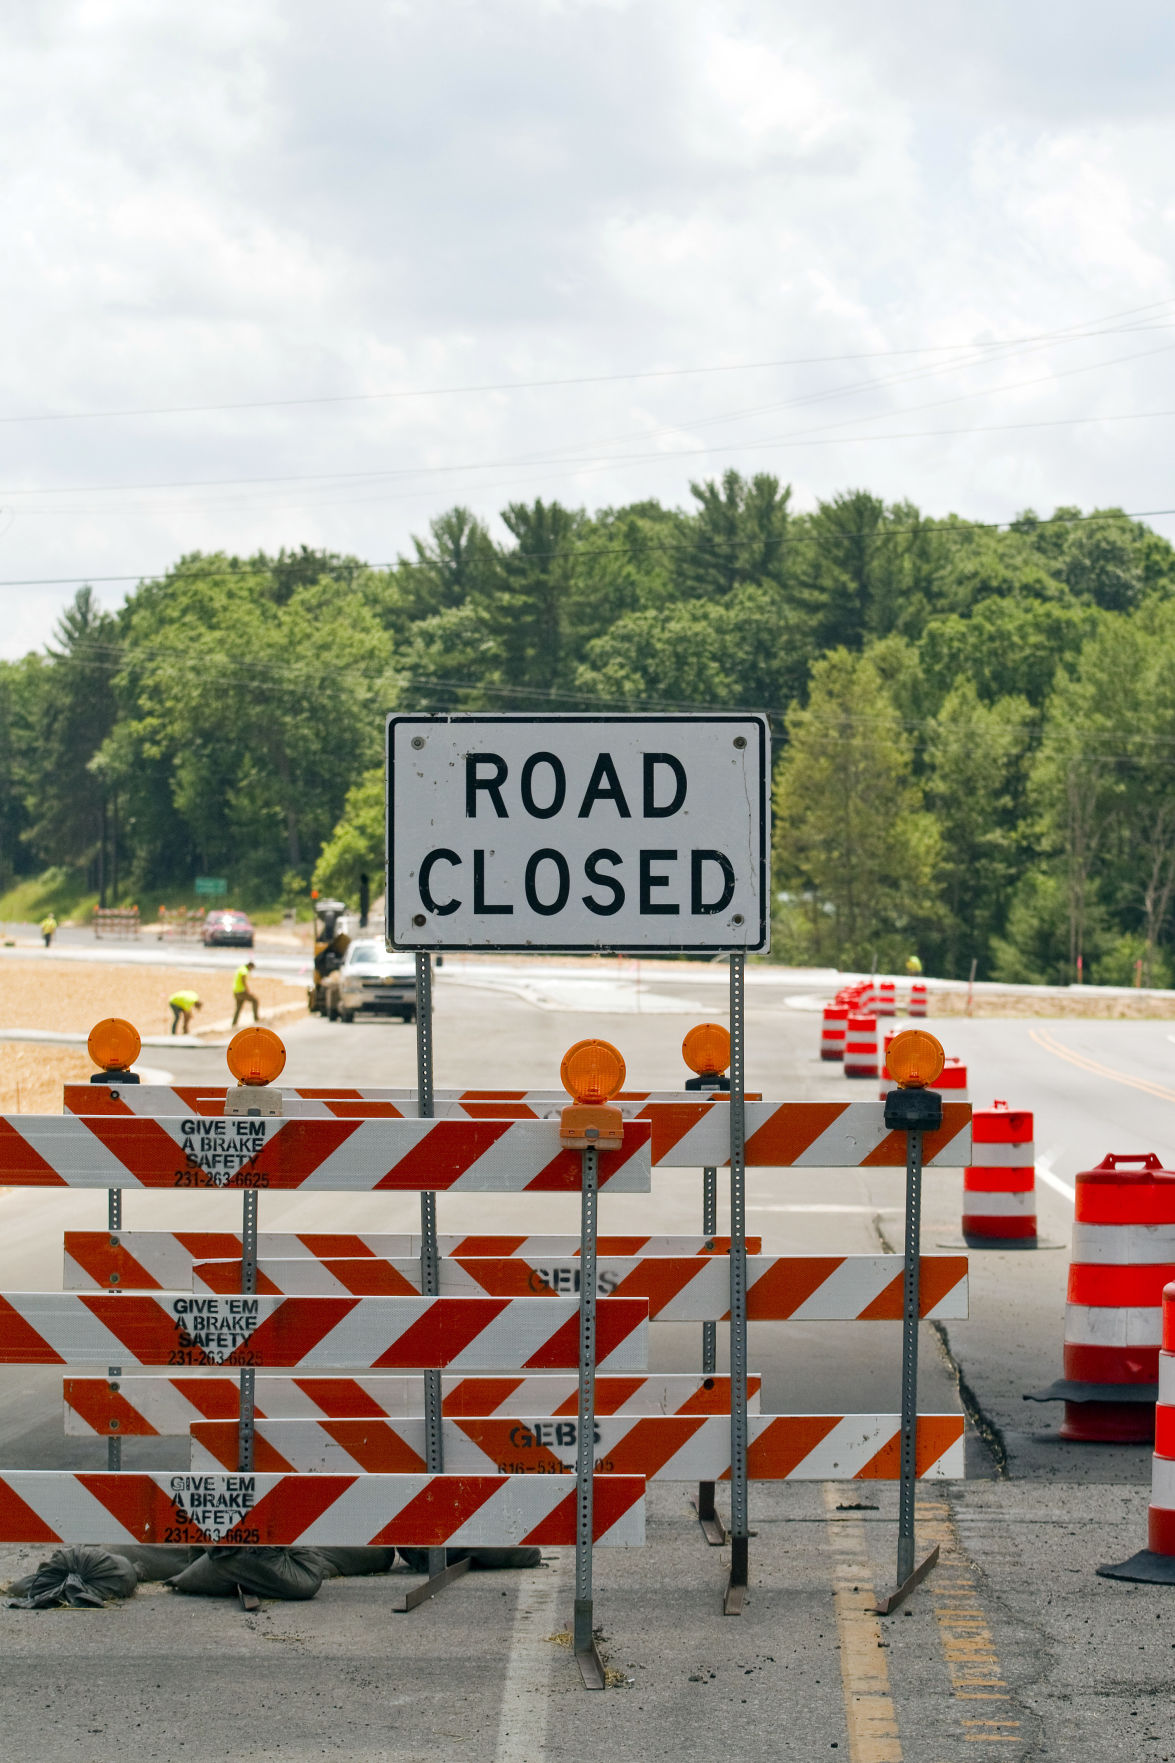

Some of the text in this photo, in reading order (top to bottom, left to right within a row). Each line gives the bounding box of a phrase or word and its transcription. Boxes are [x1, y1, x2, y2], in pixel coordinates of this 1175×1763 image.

[465, 751, 688, 819] ROAD
[418, 847, 736, 916] CLOSED
[181, 1119, 266, 1136] GIVE 'EM
[182, 1137, 264, 1152] A BRAKE
[186, 1154, 259, 1169] SAFETY
[174, 1171, 270, 1188] 231-263-6625
[173, 1299, 259, 1314] GIVE 'EM
[175, 1316, 257, 1331] A BRAKE
[179, 1332, 254, 1348] SAFETY
[168, 1351, 264, 1366] 231-263-6625
[170, 1476, 255, 1491] GIVE 'EM
[171, 1493, 255, 1508] A BRAKE
[175, 1509, 250, 1525] SAFETY
[164, 1528, 260, 1543] 231-263-6625
